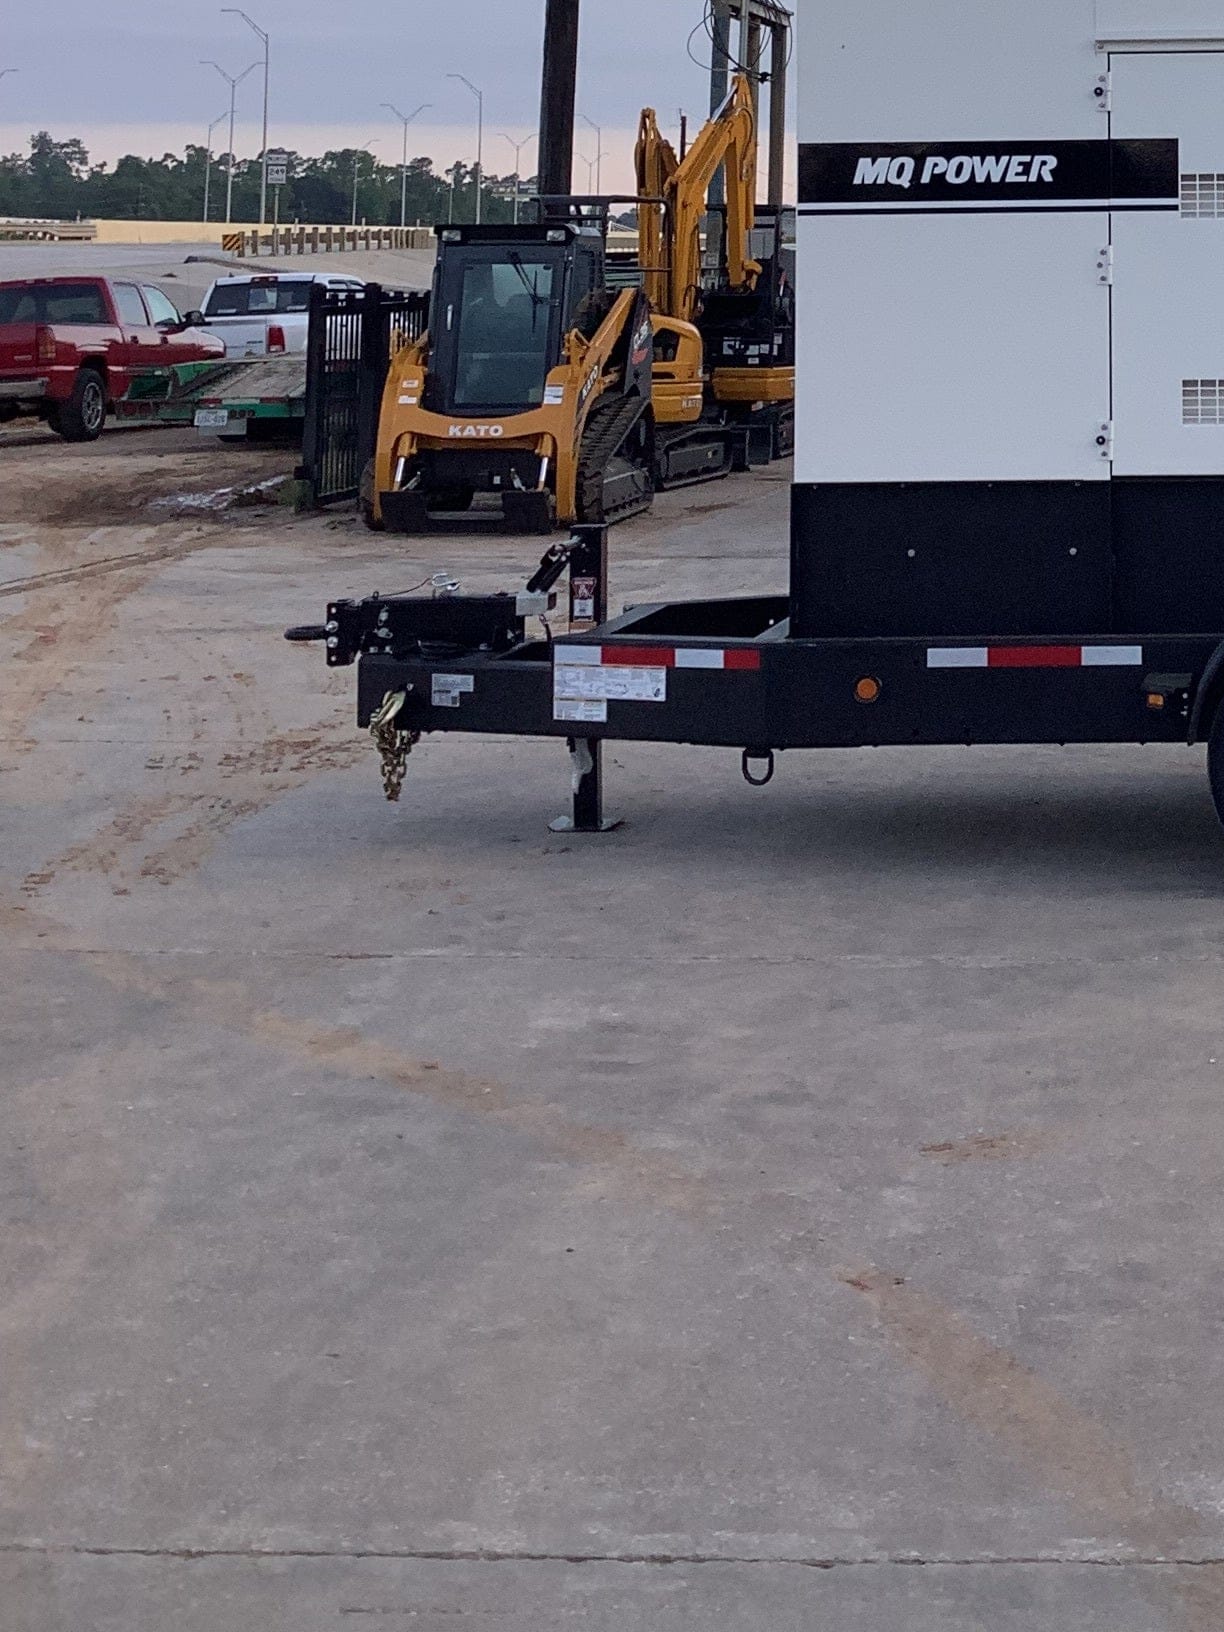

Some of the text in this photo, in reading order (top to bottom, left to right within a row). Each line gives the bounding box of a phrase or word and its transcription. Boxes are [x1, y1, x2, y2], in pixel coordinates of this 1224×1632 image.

[853, 154, 1058, 188] MQ POWER
[448, 425, 504, 437] KATO
